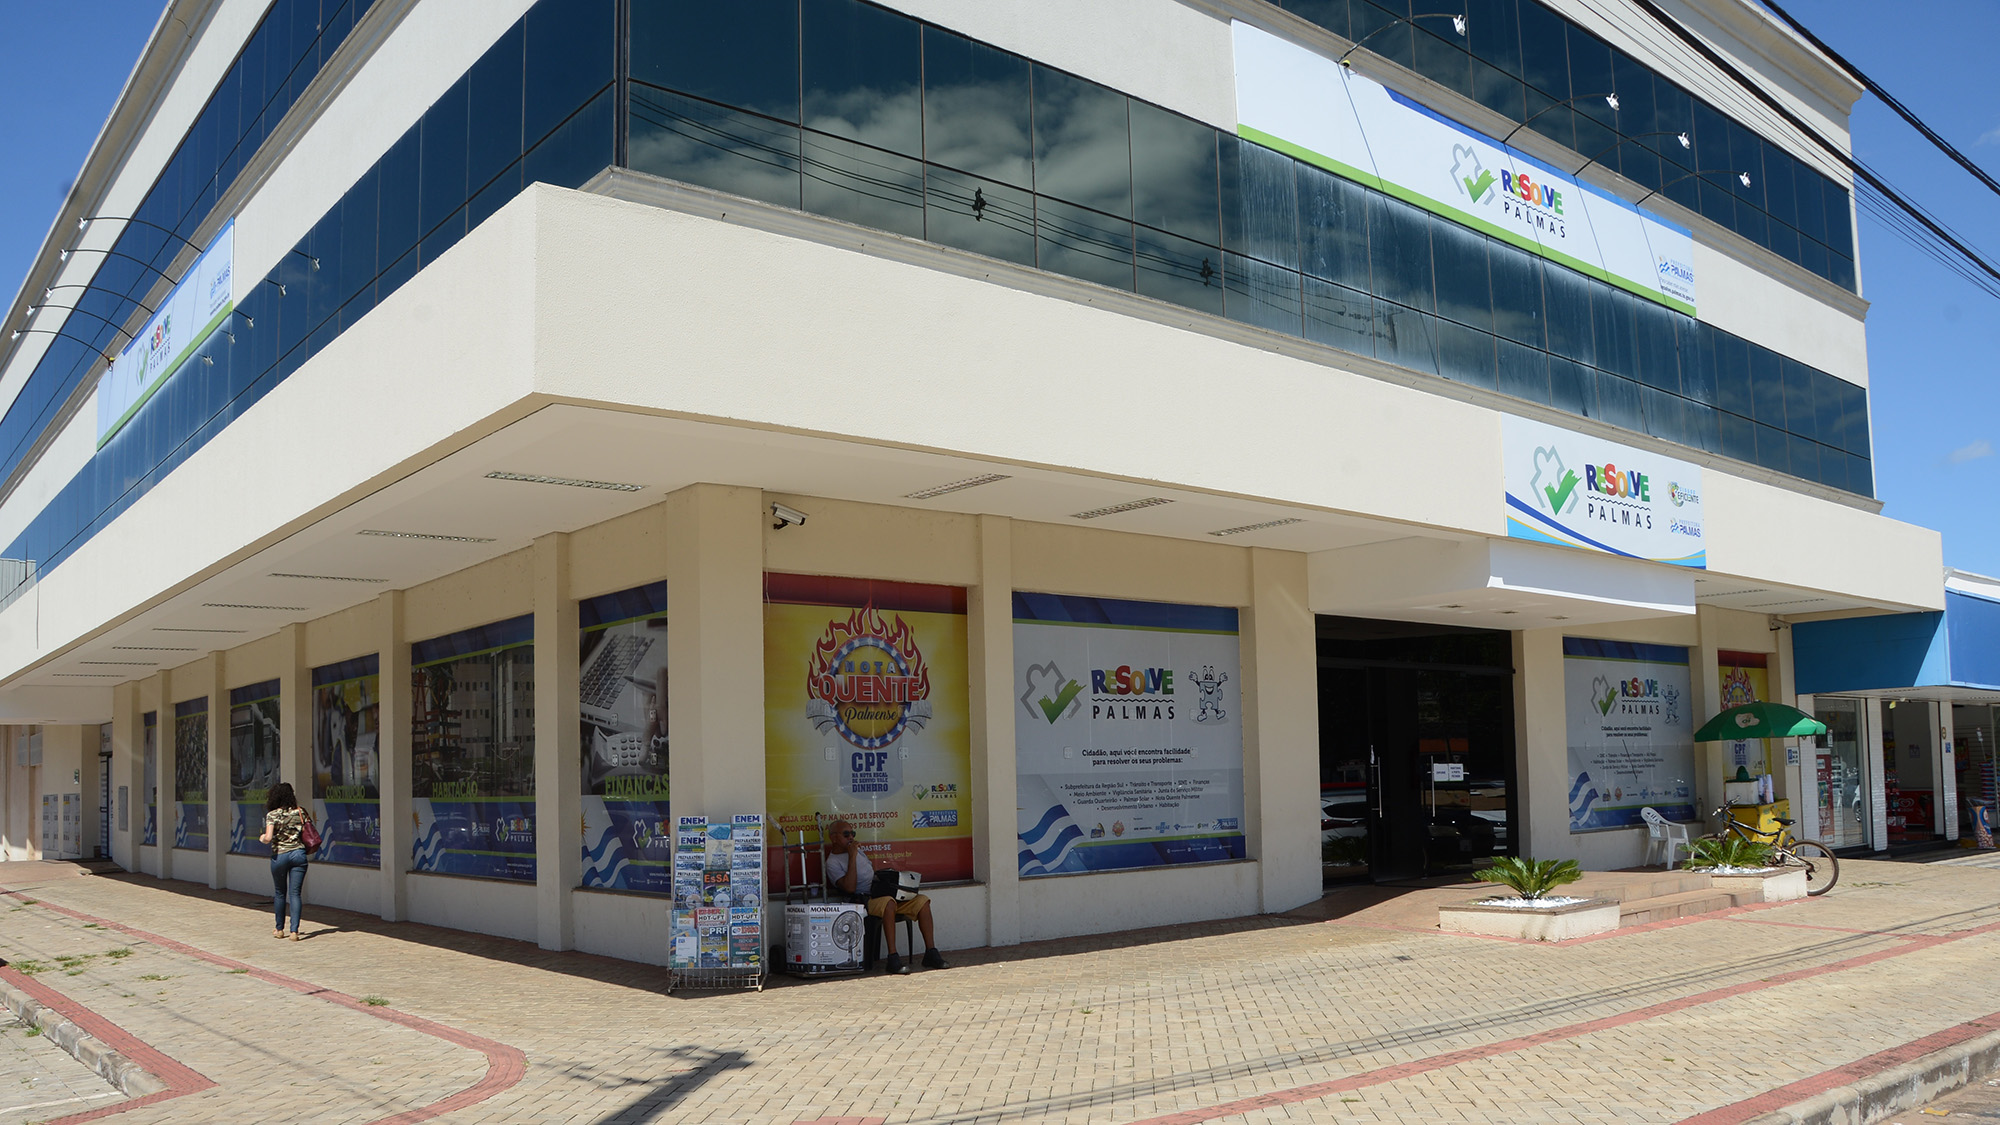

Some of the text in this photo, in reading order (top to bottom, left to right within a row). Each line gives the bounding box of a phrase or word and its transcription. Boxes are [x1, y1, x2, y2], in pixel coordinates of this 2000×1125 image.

[1501, 169, 1564, 216] RESOLVE
[1504, 201, 1565, 239] PALMAS
[1671, 264, 1694, 283] PALMAS
[151, 314, 171, 355] RESOLVE
[150, 340, 171, 373] PALMAS
[1585, 463, 1651, 502] RESOLVE
[1677, 491, 1699, 504] EFICIENTE
[1588, 503, 1652, 530] PALMAS
[1679, 524, 1701, 538] PALMAS
[845, 661, 897, 674] NOTA
[1091, 665, 1174, 695] RESOLVE
[1621, 677, 1659, 698] RESOLVE
[819, 675, 921, 707] QUENTE
[844, 705, 898, 724] Palmense
[1093, 705, 1175, 720] PALMAS
[1622, 705, 1660, 715] PALMAS
[1082, 749, 1108, 757] Cidadão,
[1110, 749, 1122, 757] aqui
[851, 752, 888, 772] CPF
[432, 778, 478, 804] HABITAÇÃO
[931, 783, 957, 792] RESOLVE
[680, 817, 706, 825] ENEM
[735, 815, 760, 823] ENEM
[840, 813, 858, 821] NOTA
[859, 812, 868, 820] DE
[869, 811, 898, 820] SERVIÇOS
[930, 815, 957, 823] PALMAS
[680, 837, 706, 845] ENEM
[704, 873, 729, 883] EsSA
[709, 926, 727, 934] PRF
